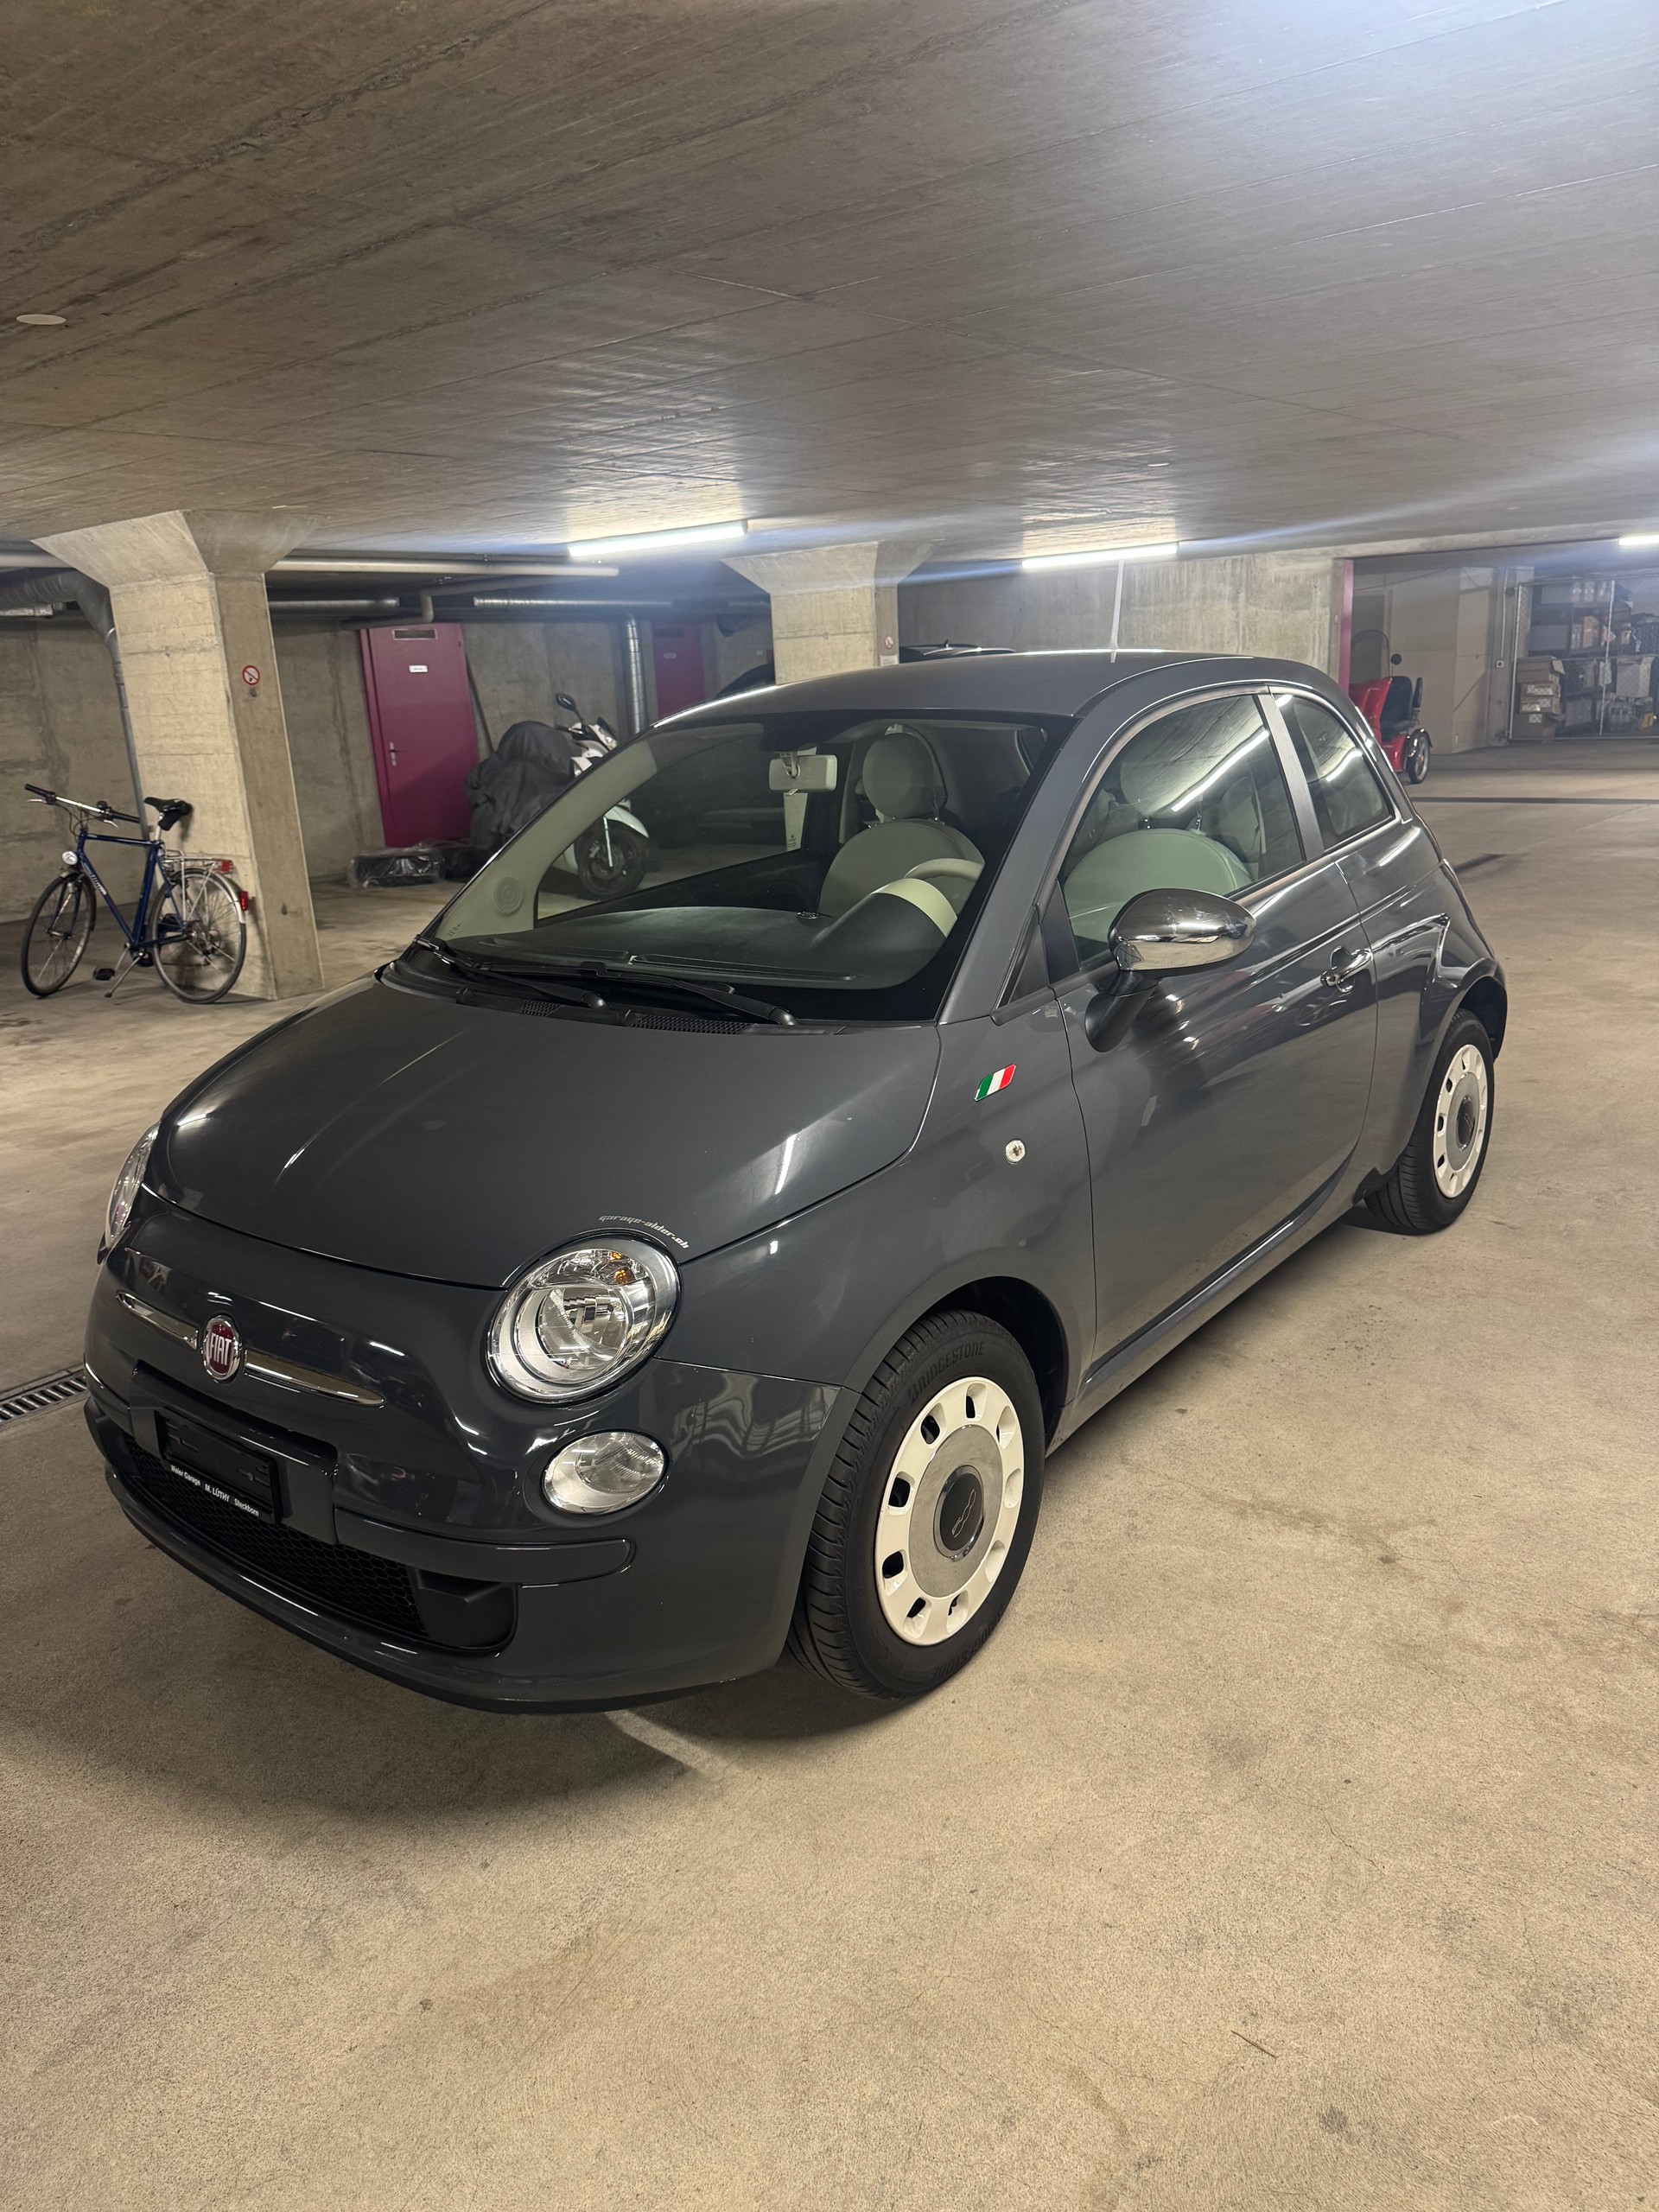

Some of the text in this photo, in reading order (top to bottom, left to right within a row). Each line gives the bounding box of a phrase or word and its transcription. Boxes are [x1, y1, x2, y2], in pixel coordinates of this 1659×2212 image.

[210, 467, 232, 501] FIAT
[908, 1341, 985, 1406] BRIDGESTONE
[184, 1471, 200, 1486] Garage
[234, 1498, 259, 1517] Steckborn
